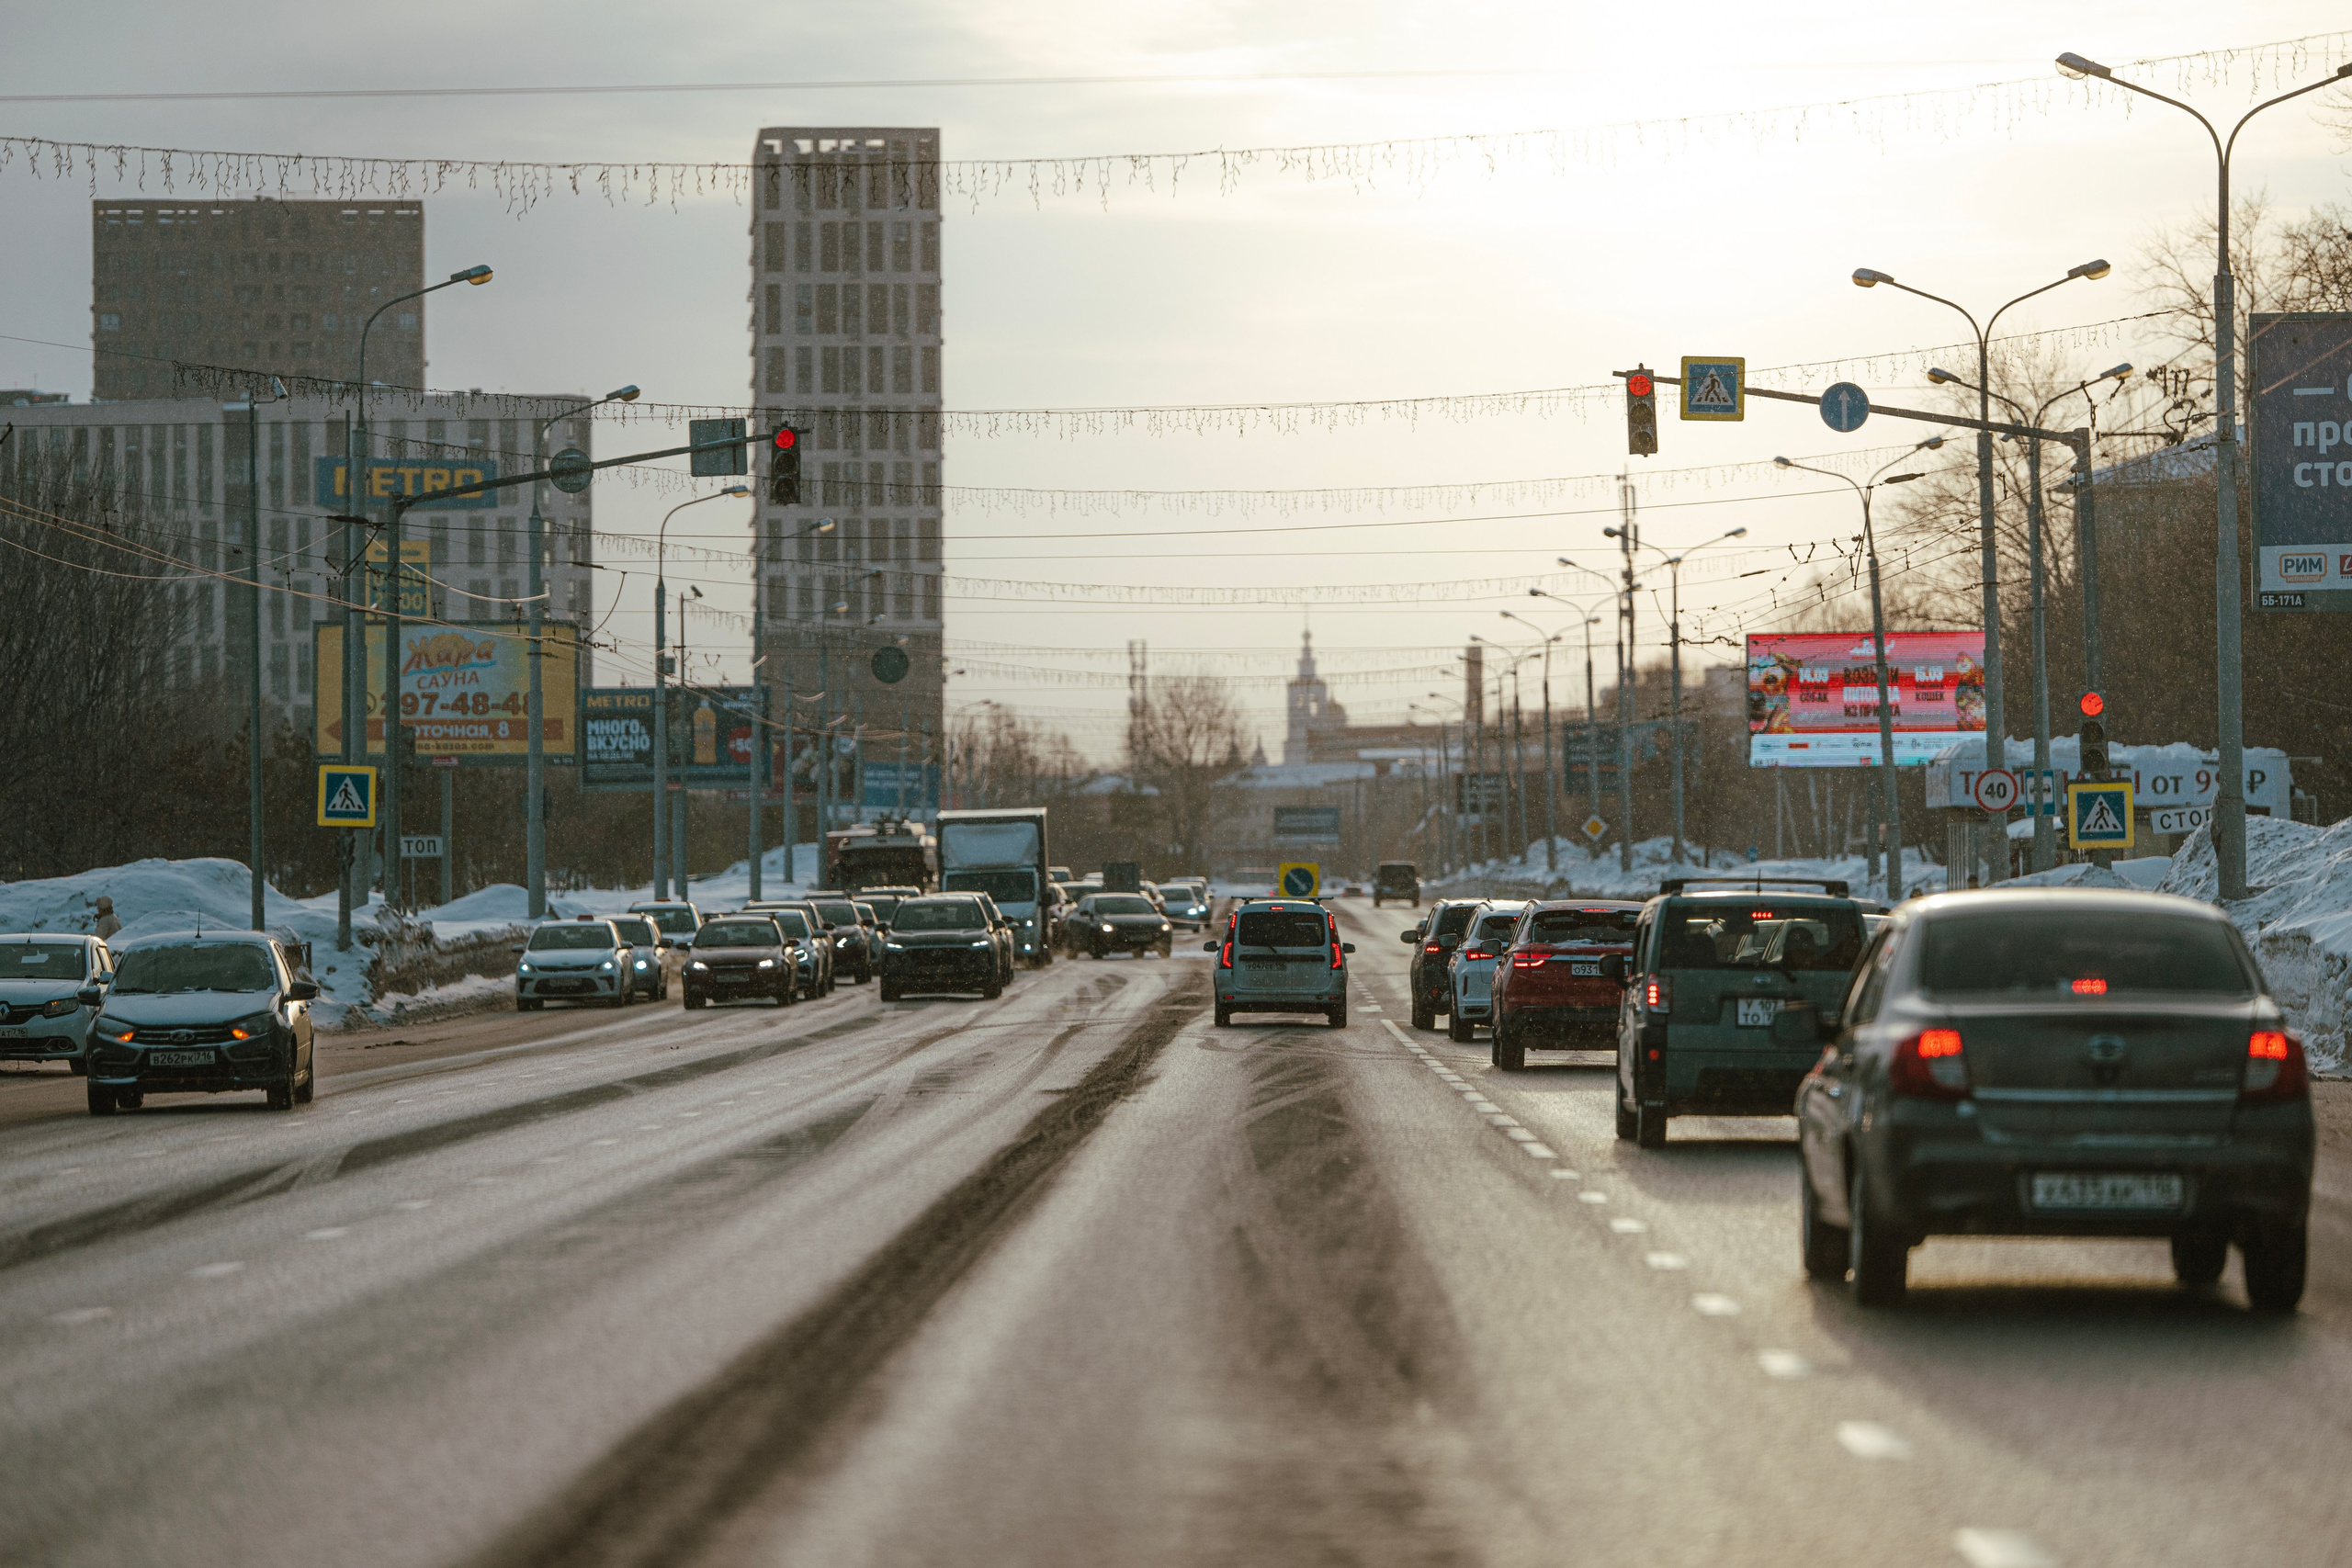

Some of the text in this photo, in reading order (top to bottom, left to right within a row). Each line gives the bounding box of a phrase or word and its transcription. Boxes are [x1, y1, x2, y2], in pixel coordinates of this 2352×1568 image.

[2284, 557, 2323, 573] РИМ
[416, 670, 480, 690] САУНА
[1799, 667, 1829, 682] 14.03
[1844, 666, 1899, 683] ВОЗЬИ
[1915, 665, 1944, 682] 15.03
[586, 694, 651, 707] METRO
[1859, 703, 1901, 716] ПРИТА
[498, 720, 510, 739] 8
[587, 733, 651, 751] ВКУСНО
[1984, 781, 2007, 799] 40
[2195, 770, 2219, 795] 9
